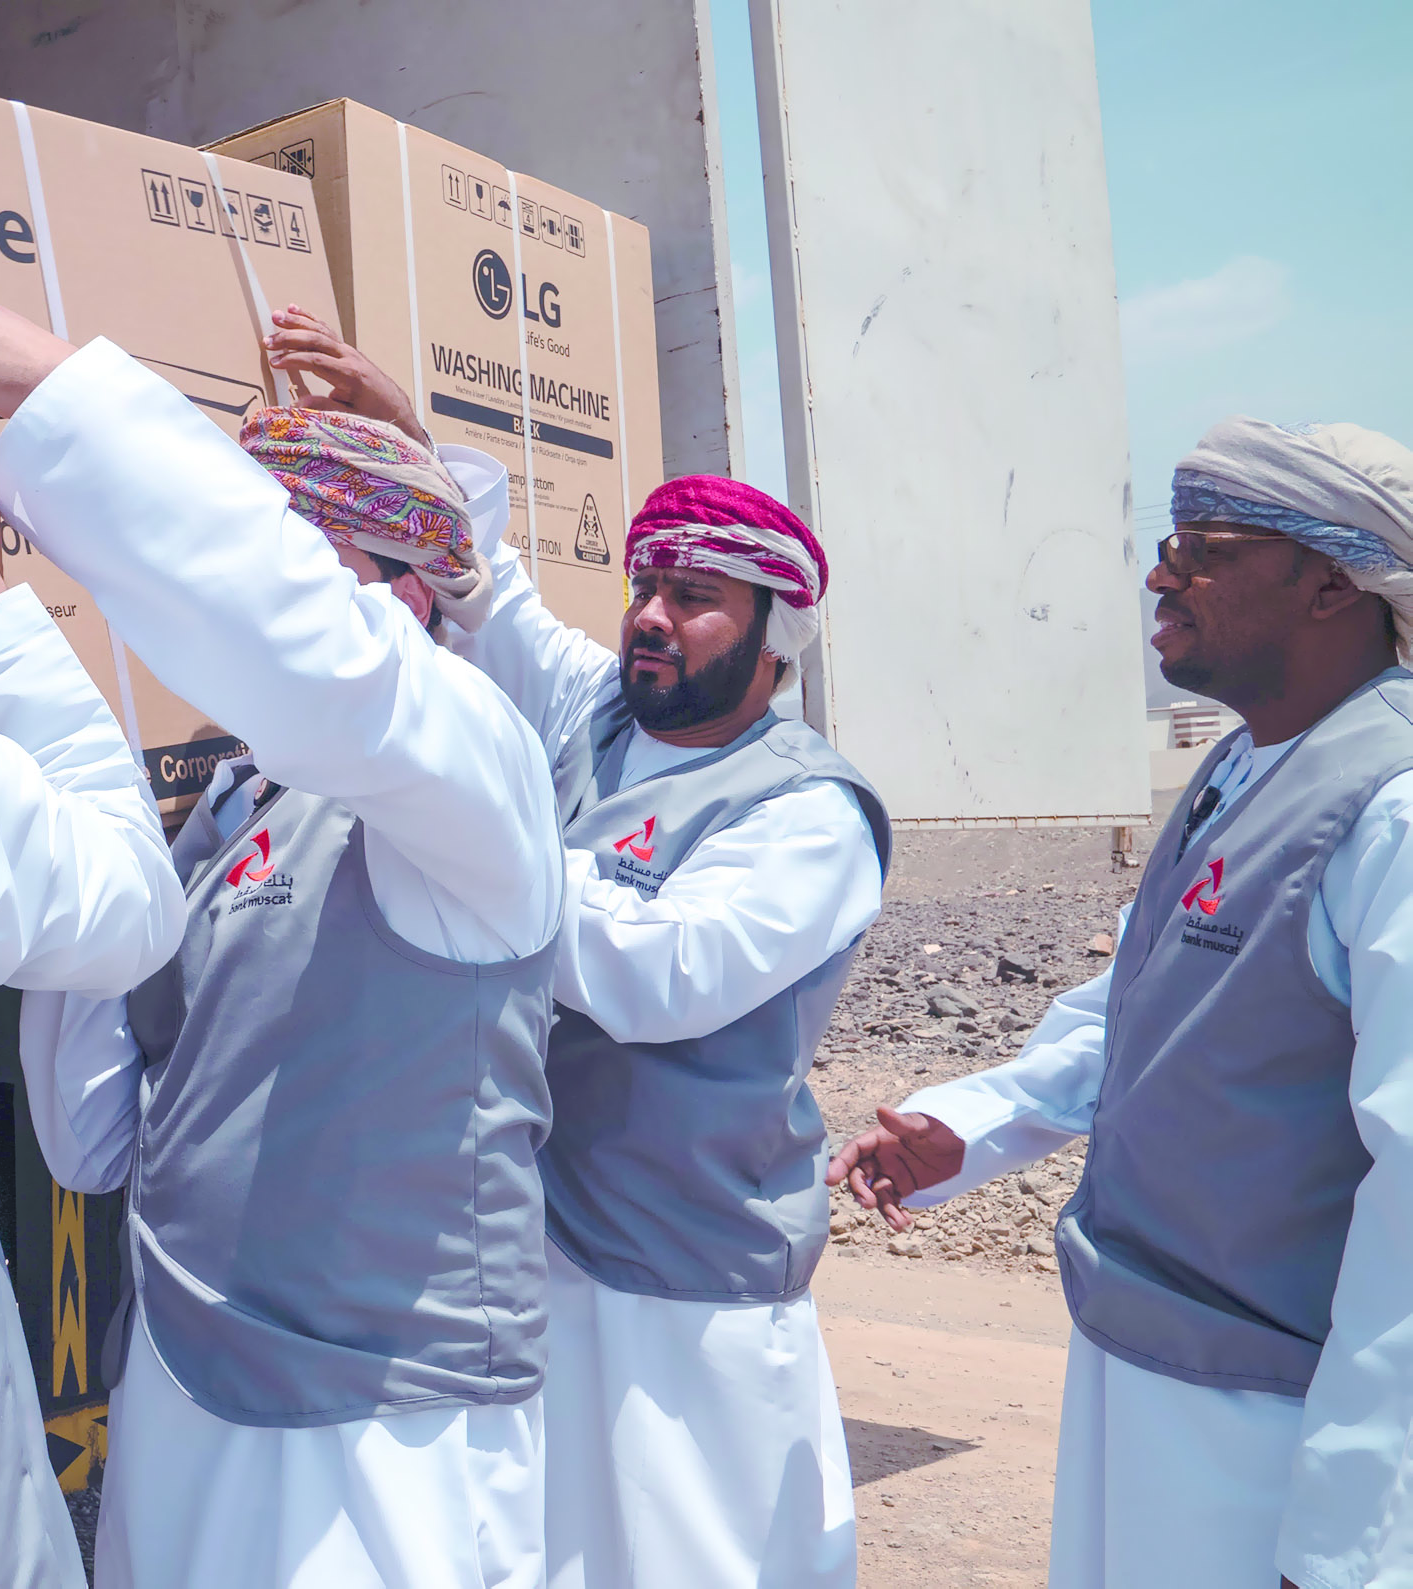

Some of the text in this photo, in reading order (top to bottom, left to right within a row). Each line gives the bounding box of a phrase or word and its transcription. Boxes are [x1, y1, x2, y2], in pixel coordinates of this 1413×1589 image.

[522, 273, 561, 328] LG
[525, 331, 570, 357] ife's Good
[431, 343, 610, 421] WASHING MACHINE
[508, 473, 525, 488] amp
[522, 535, 561, 556] CUTION
[46, 604, 77, 618] seur
[615, 869, 657, 892] bank mus
[248, 892, 293, 908] muscat
[1181, 929, 1241, 956] bank muscat
